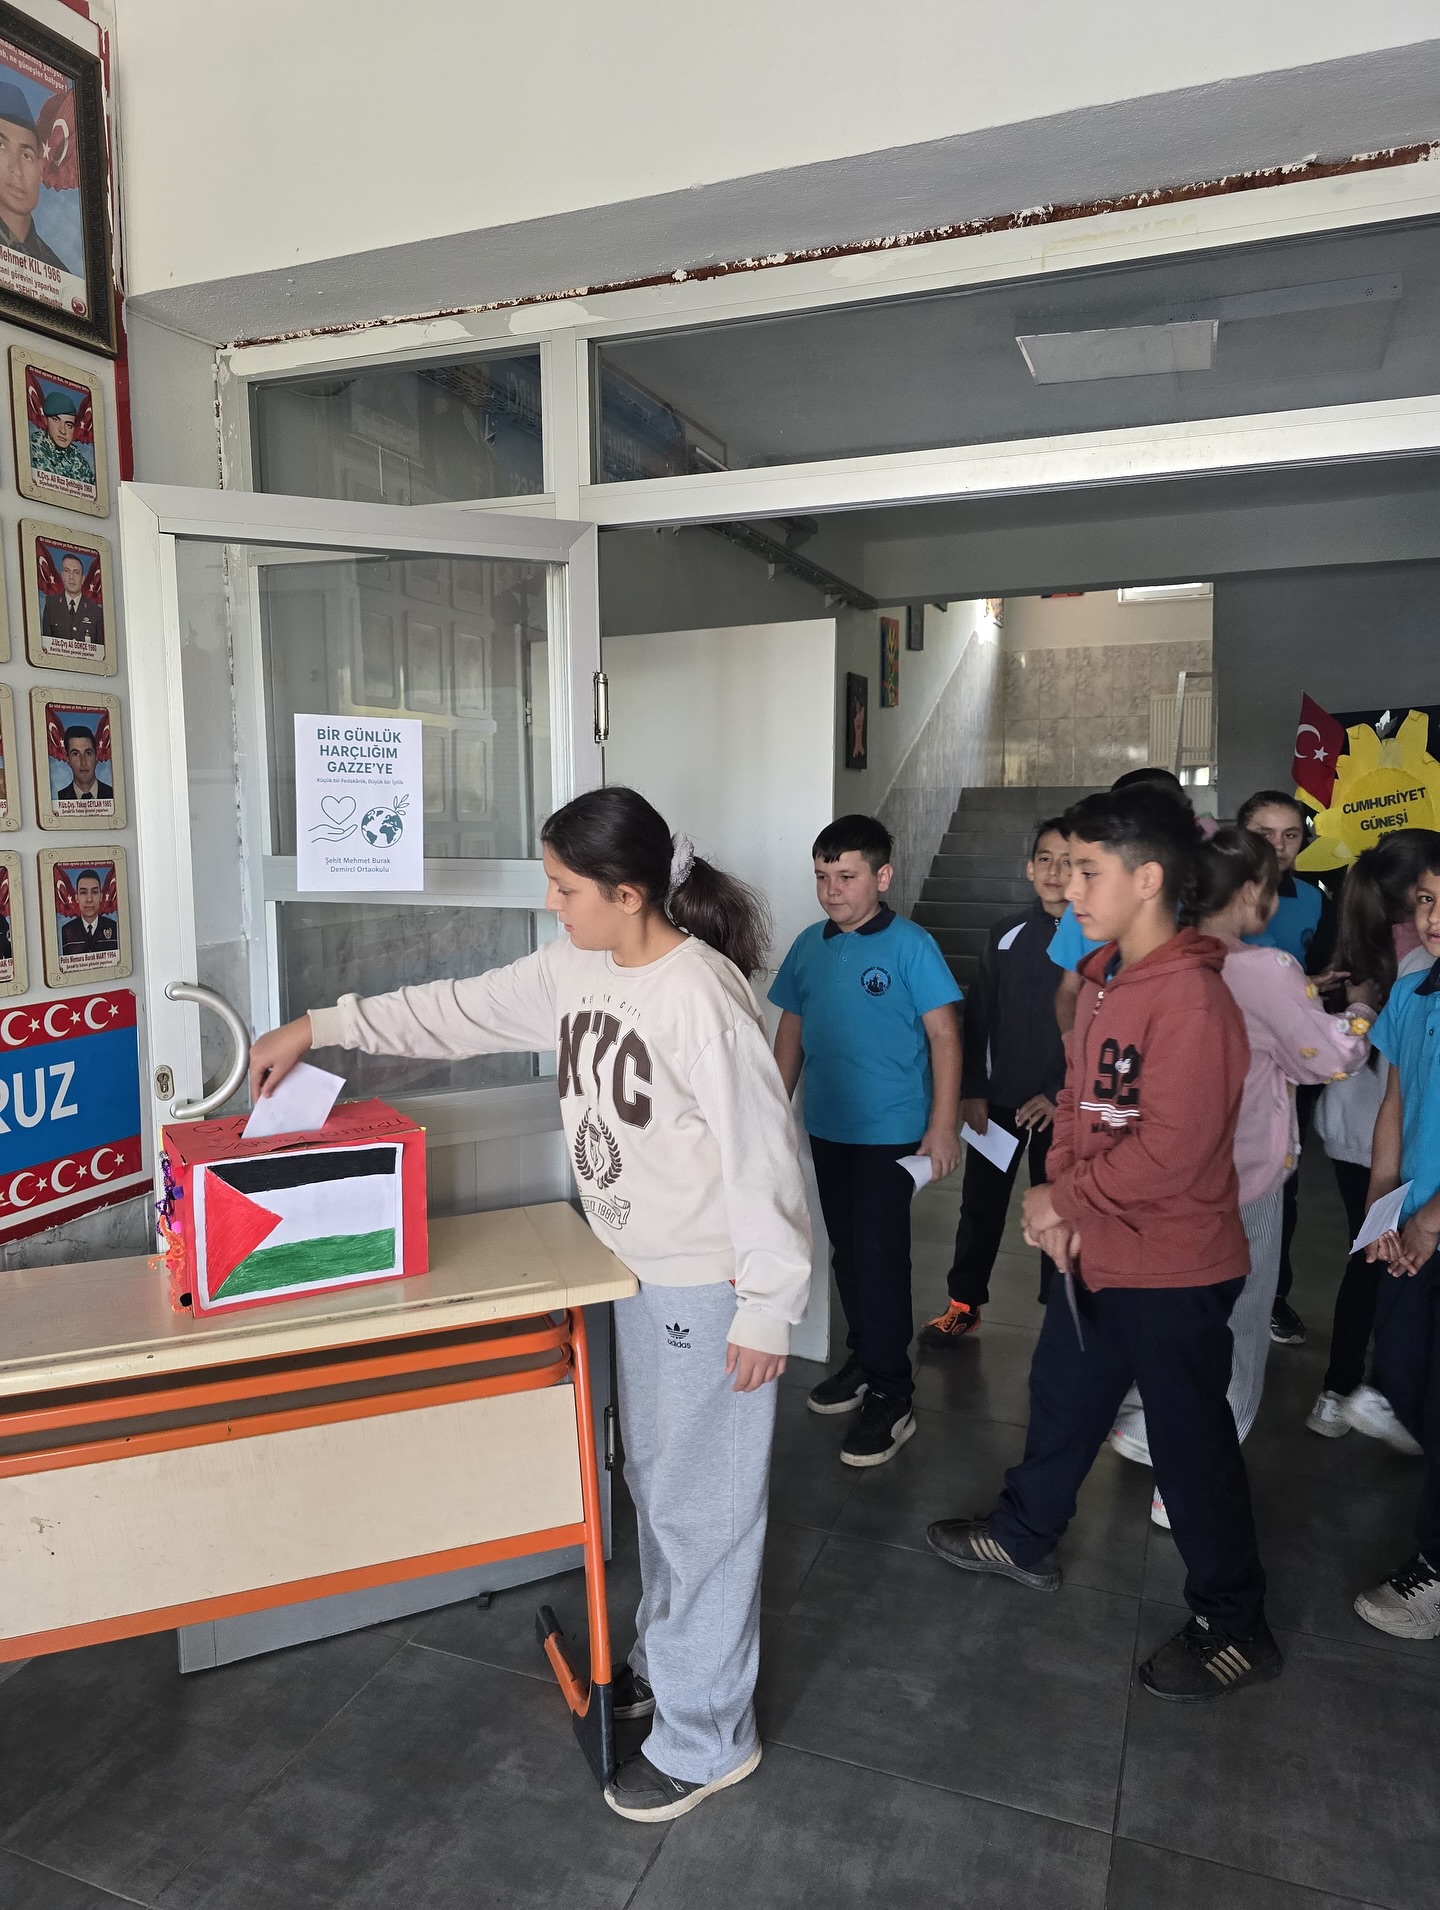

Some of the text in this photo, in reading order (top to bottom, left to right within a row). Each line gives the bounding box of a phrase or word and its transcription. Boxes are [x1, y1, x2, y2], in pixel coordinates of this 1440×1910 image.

[10, 55, 17, 64] ne
[11, 270, 34, 286] görevini
[34, 279, 60, 296] yaparken
[44, 264, 62, 283] 1986
[317, 726, 402, 743] BİR GÜNLÜK
[320, 744, 398, 760] HARÇLIĞIM
[327, 761, 393, 775] GAZZE’YE
[1343, 787, 1426, 814] CUMHURİYET
[1360, 808, 1409, 831] GÜNEŞİ
[325, 857, 342, 865] Şehit
[558, 1009, 653, 1130] NYC
[1094, 1038, 1141, 1105] 92
